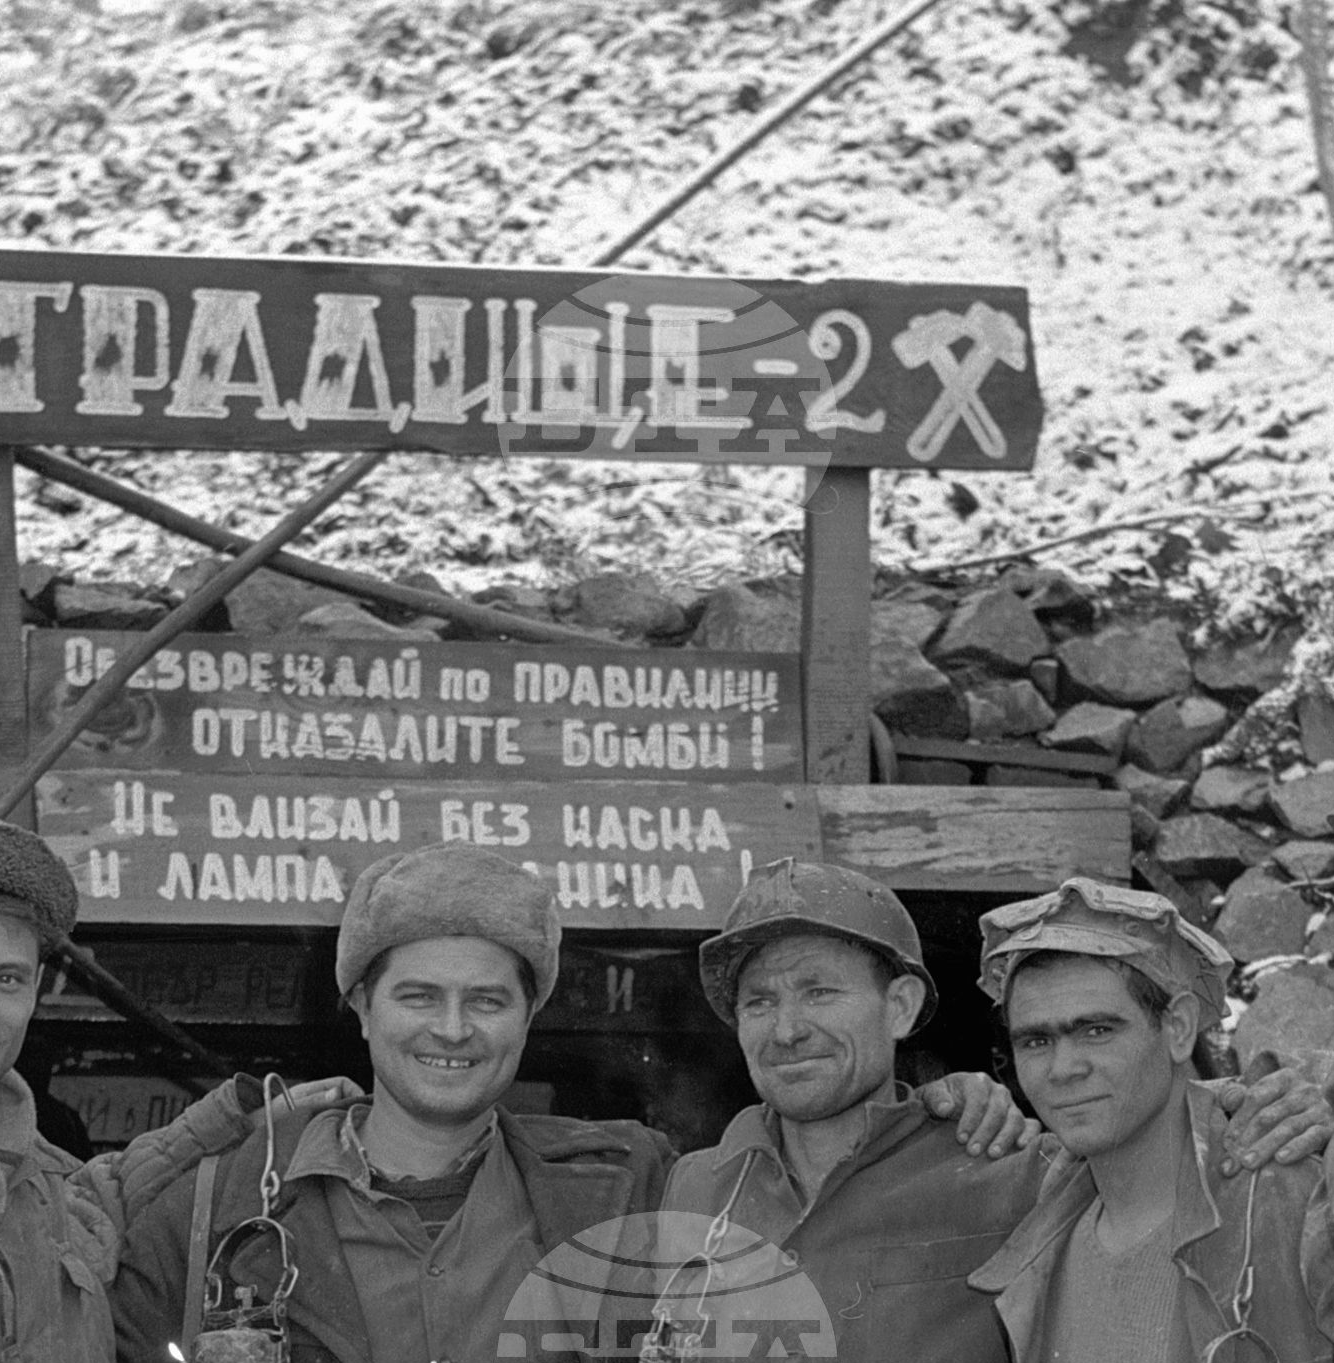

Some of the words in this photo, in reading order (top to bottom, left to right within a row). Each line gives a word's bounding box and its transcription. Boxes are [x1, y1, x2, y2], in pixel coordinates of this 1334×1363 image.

[111, 781, 179, 836] НЕ
[209, 788, 401, 843] ВЛИЗАЙ
[440, 799, 532, 847] БЕЗ
[563, 804, 731, 852] КАСКА
[89, 848, 121, 899] И
[157, 852, 345, 903] ЛАМПА
